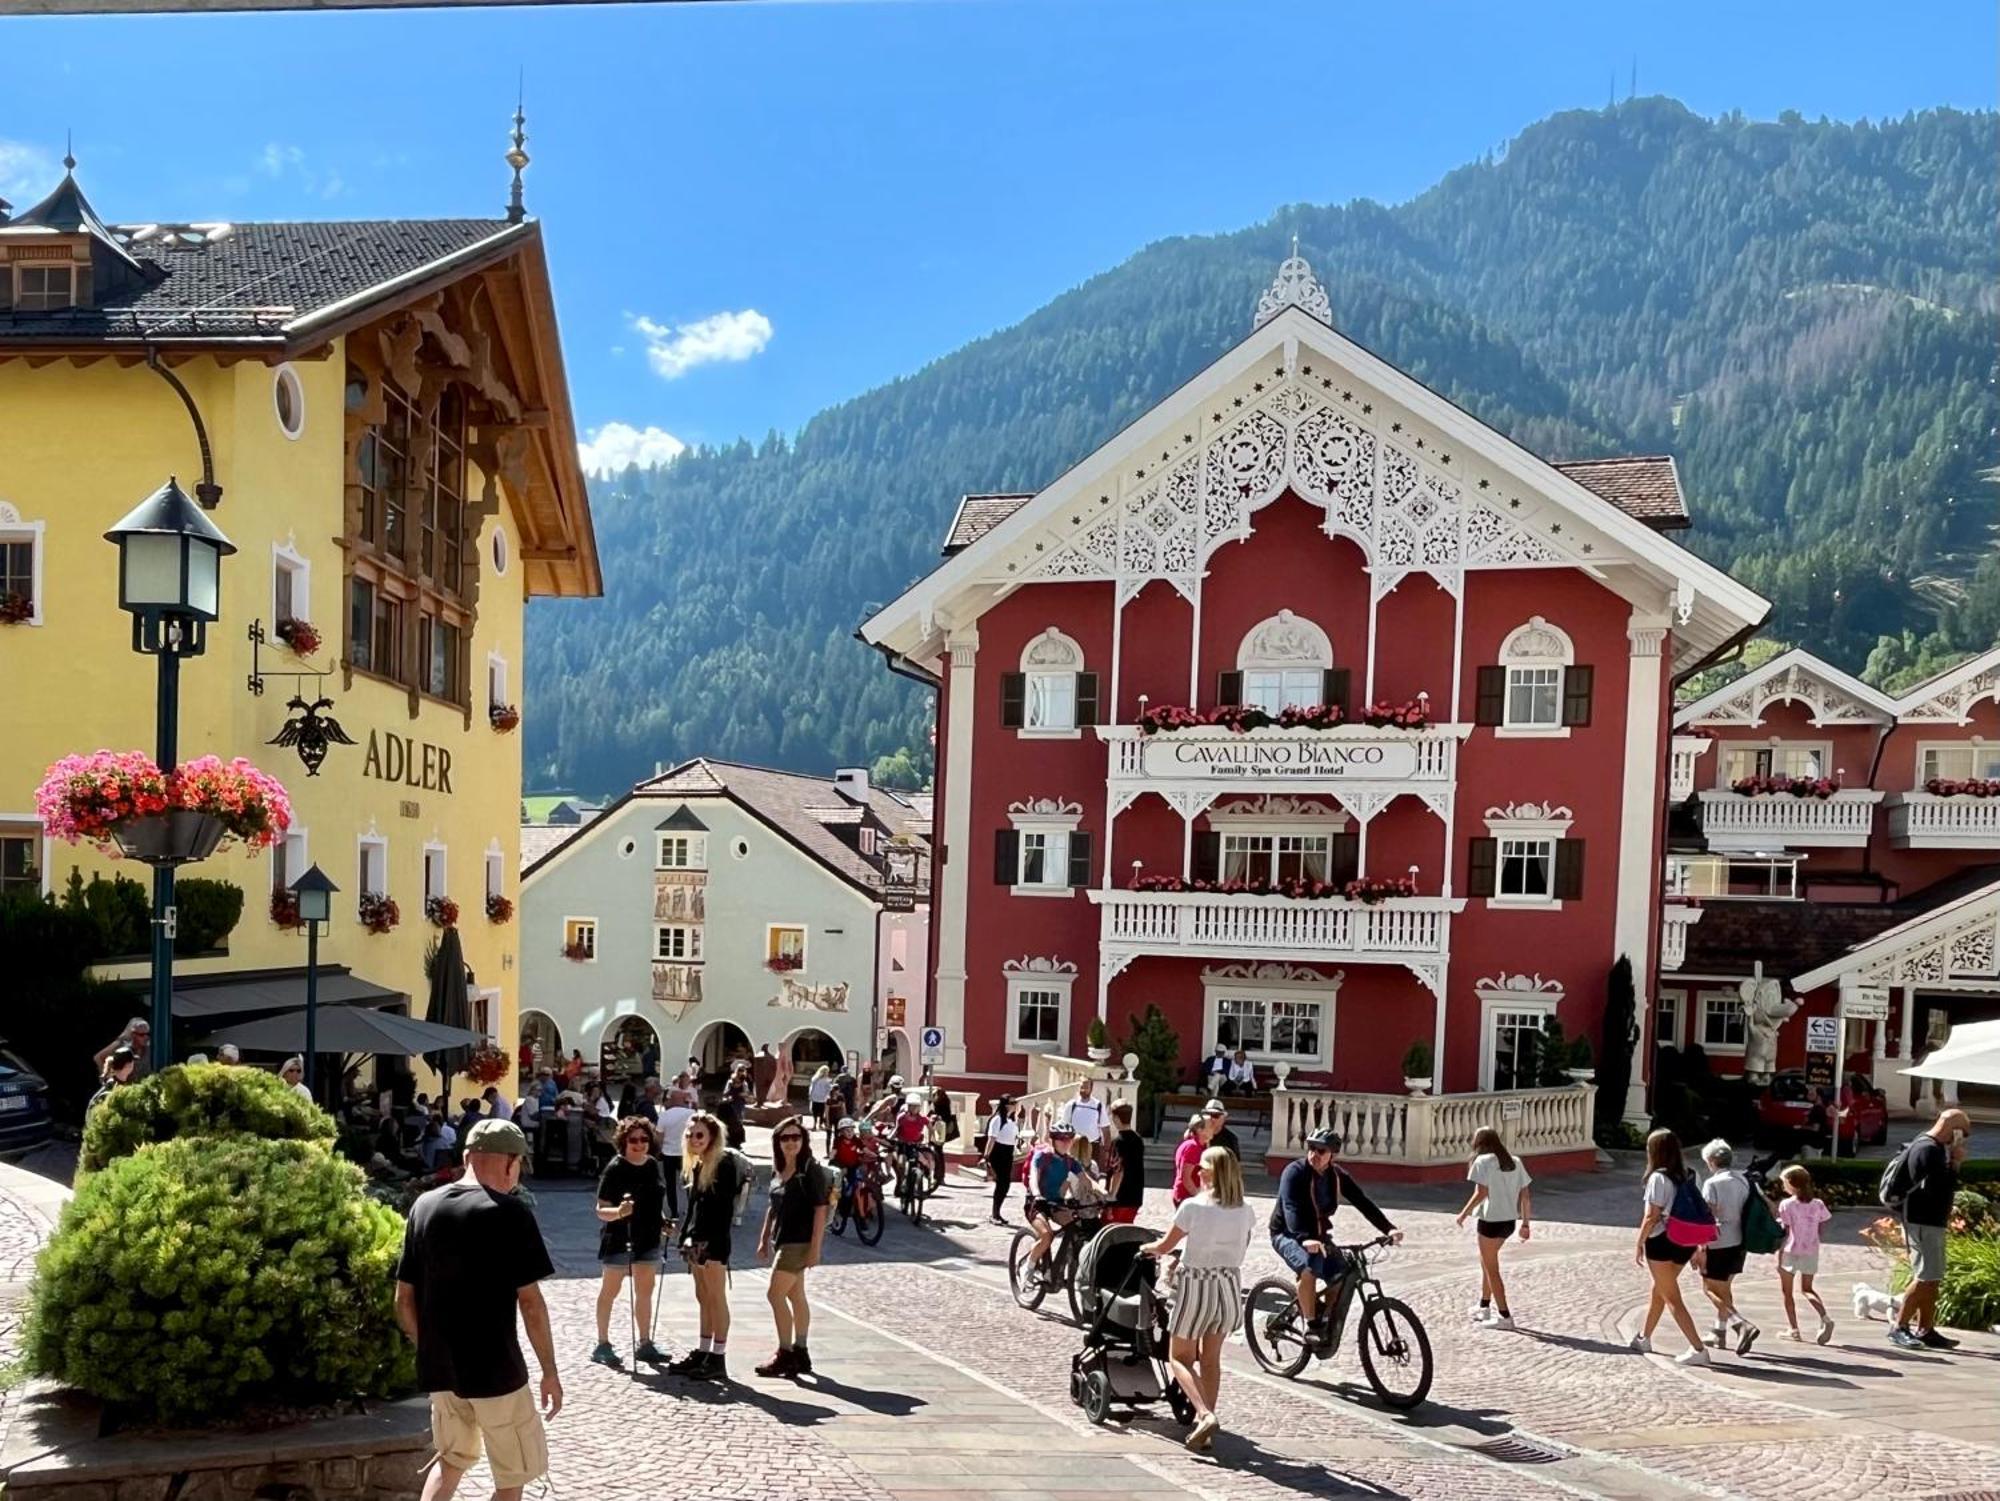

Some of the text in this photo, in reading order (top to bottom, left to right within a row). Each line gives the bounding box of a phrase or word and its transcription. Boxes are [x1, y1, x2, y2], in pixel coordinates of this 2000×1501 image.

[363, 728, 452, 794] ADLER
[1211, 765, 1344, 776] Family Spa Grand Hotel
